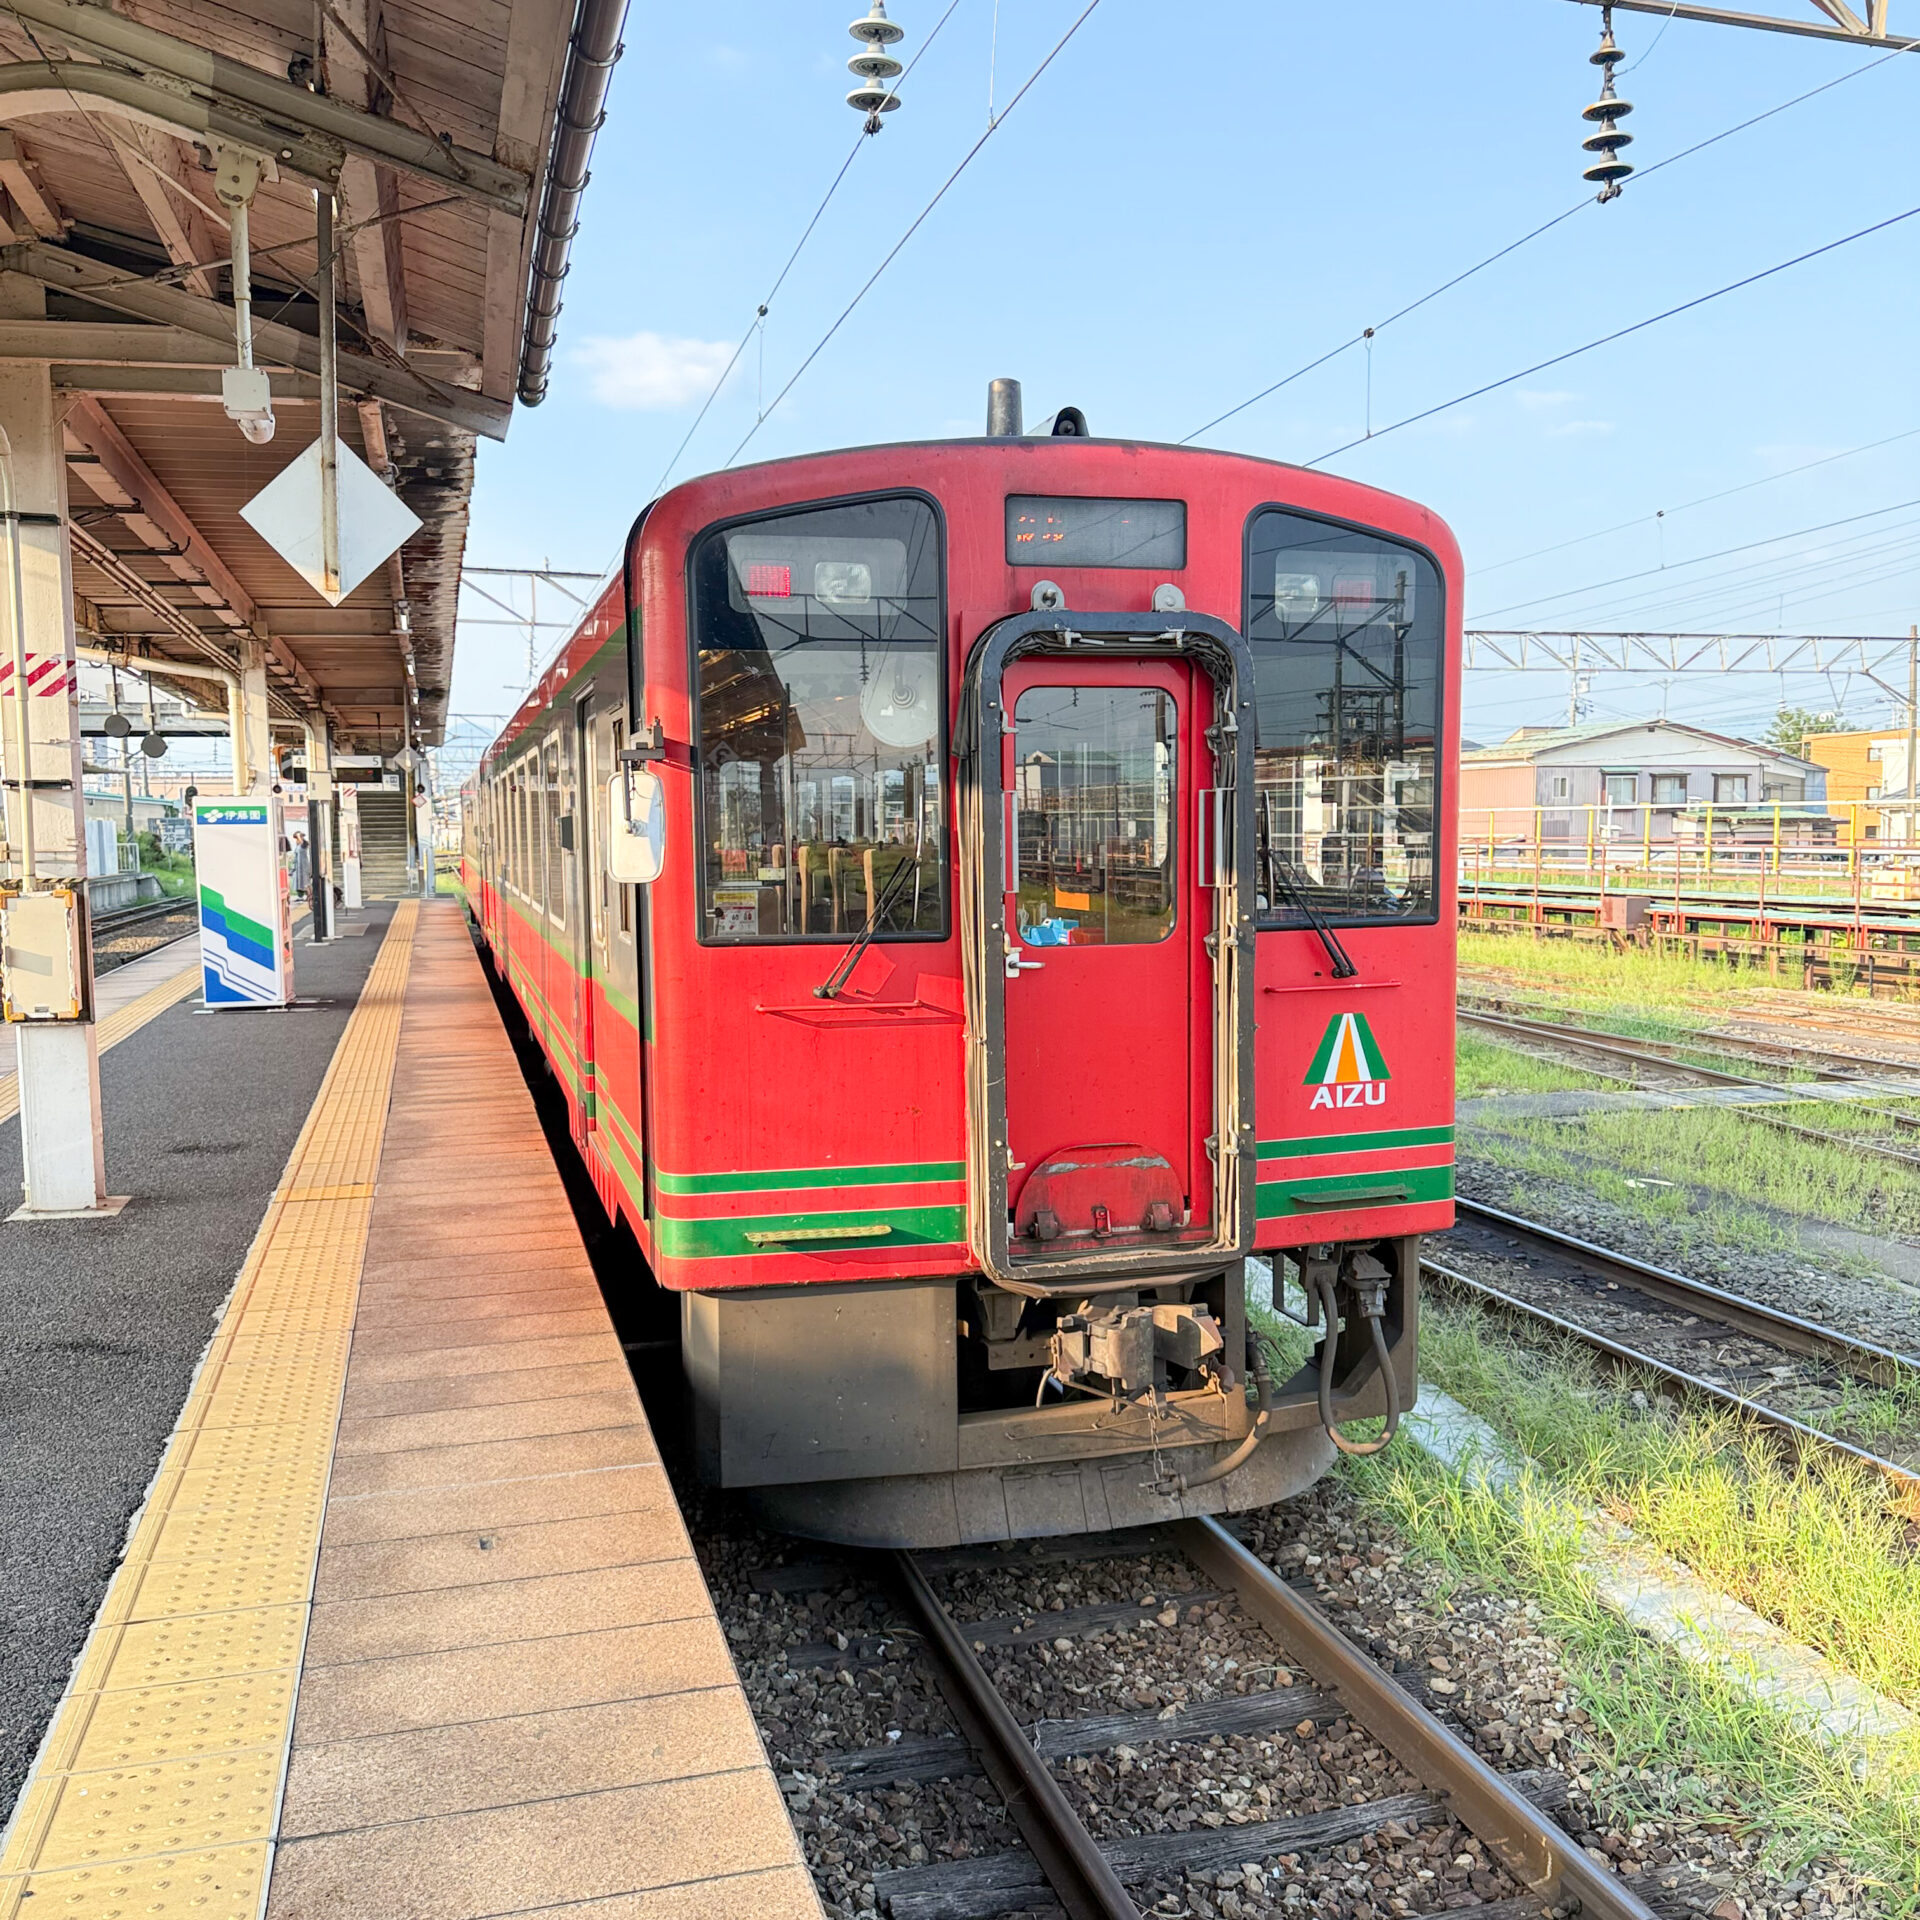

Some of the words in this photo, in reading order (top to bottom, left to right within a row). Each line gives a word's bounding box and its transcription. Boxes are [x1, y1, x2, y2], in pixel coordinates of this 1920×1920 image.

[372, 757, 379, 766] 5
[163, 833, 175, 843] 25
[1309, 1082, 1386, 1110] AIZU
